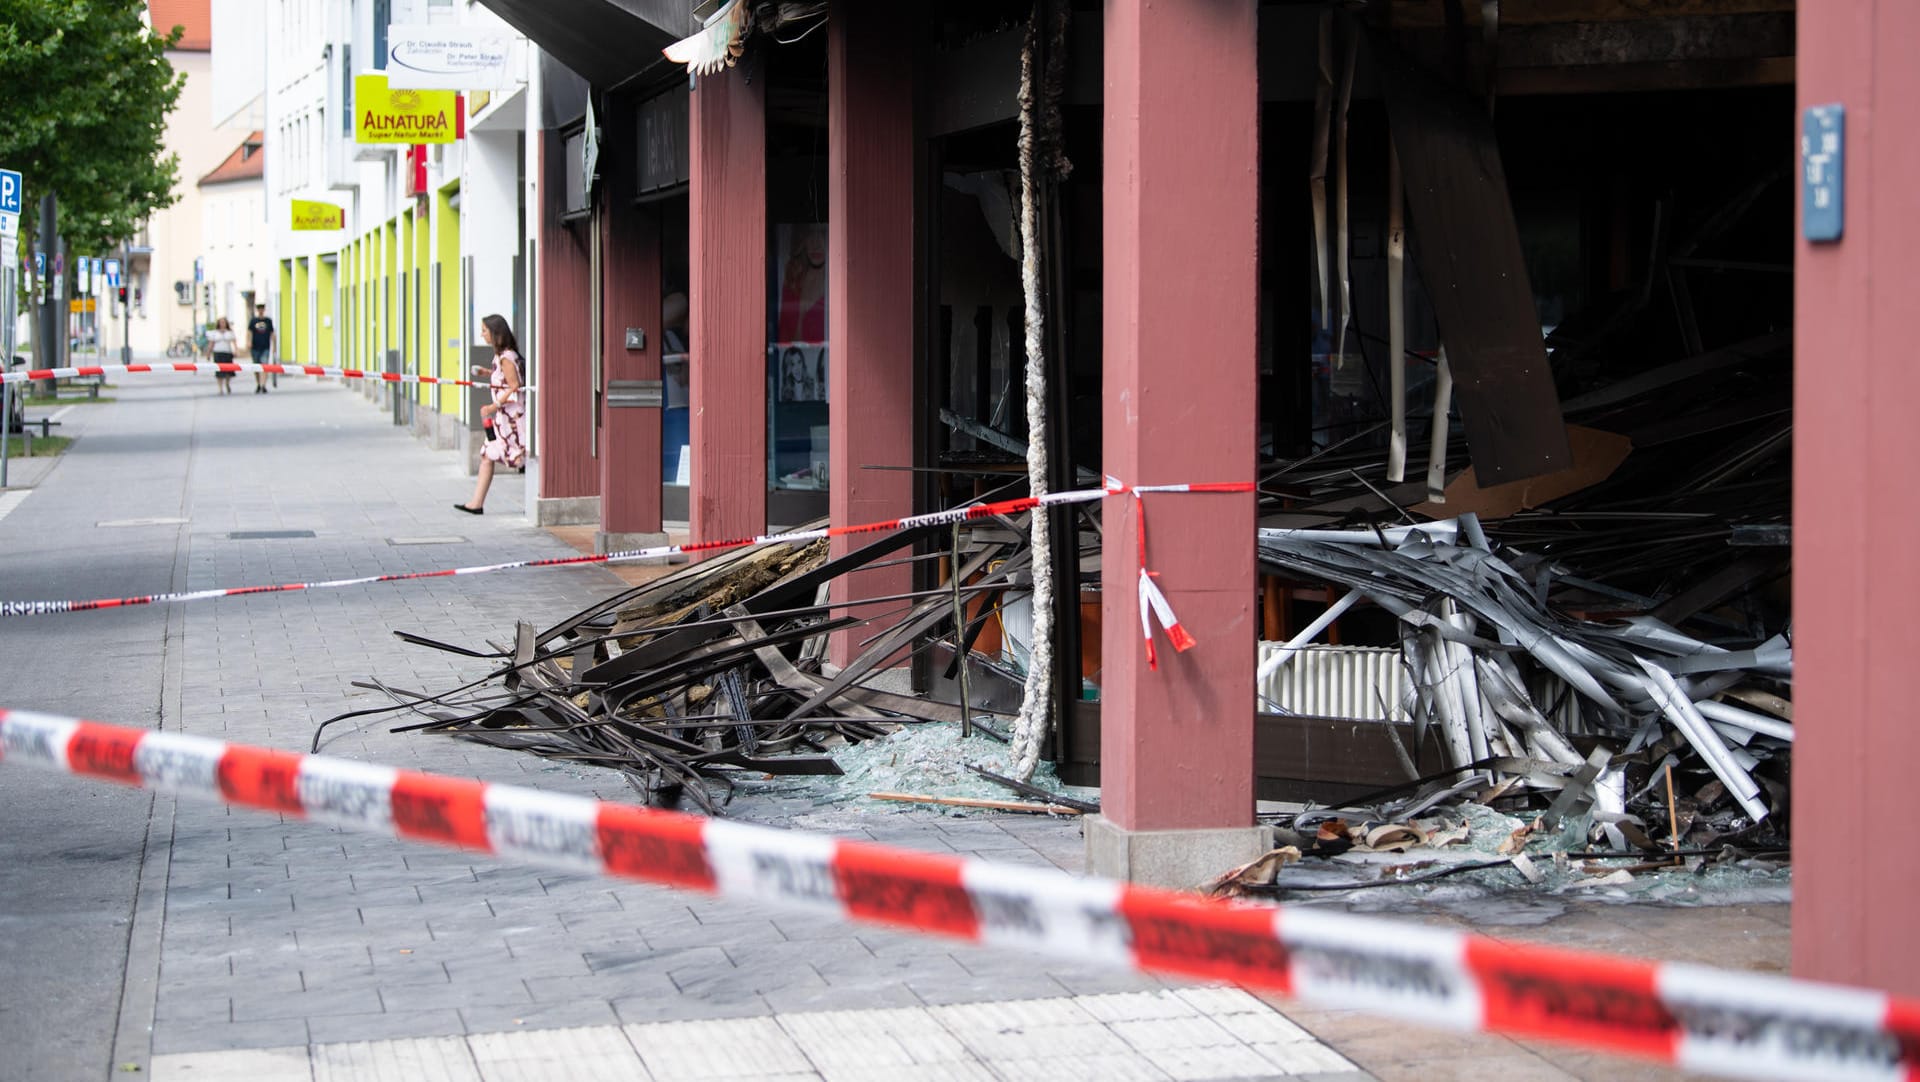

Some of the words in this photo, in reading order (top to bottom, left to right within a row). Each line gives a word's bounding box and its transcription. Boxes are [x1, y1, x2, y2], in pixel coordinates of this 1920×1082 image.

[363, 110, 449, 130] ALNATURA
[368, 131, 392, 139] Super
[394, 131, 417, 139] Natur
[419, 131, 444, 139] Markt
[1, 175, 15, 208] P
